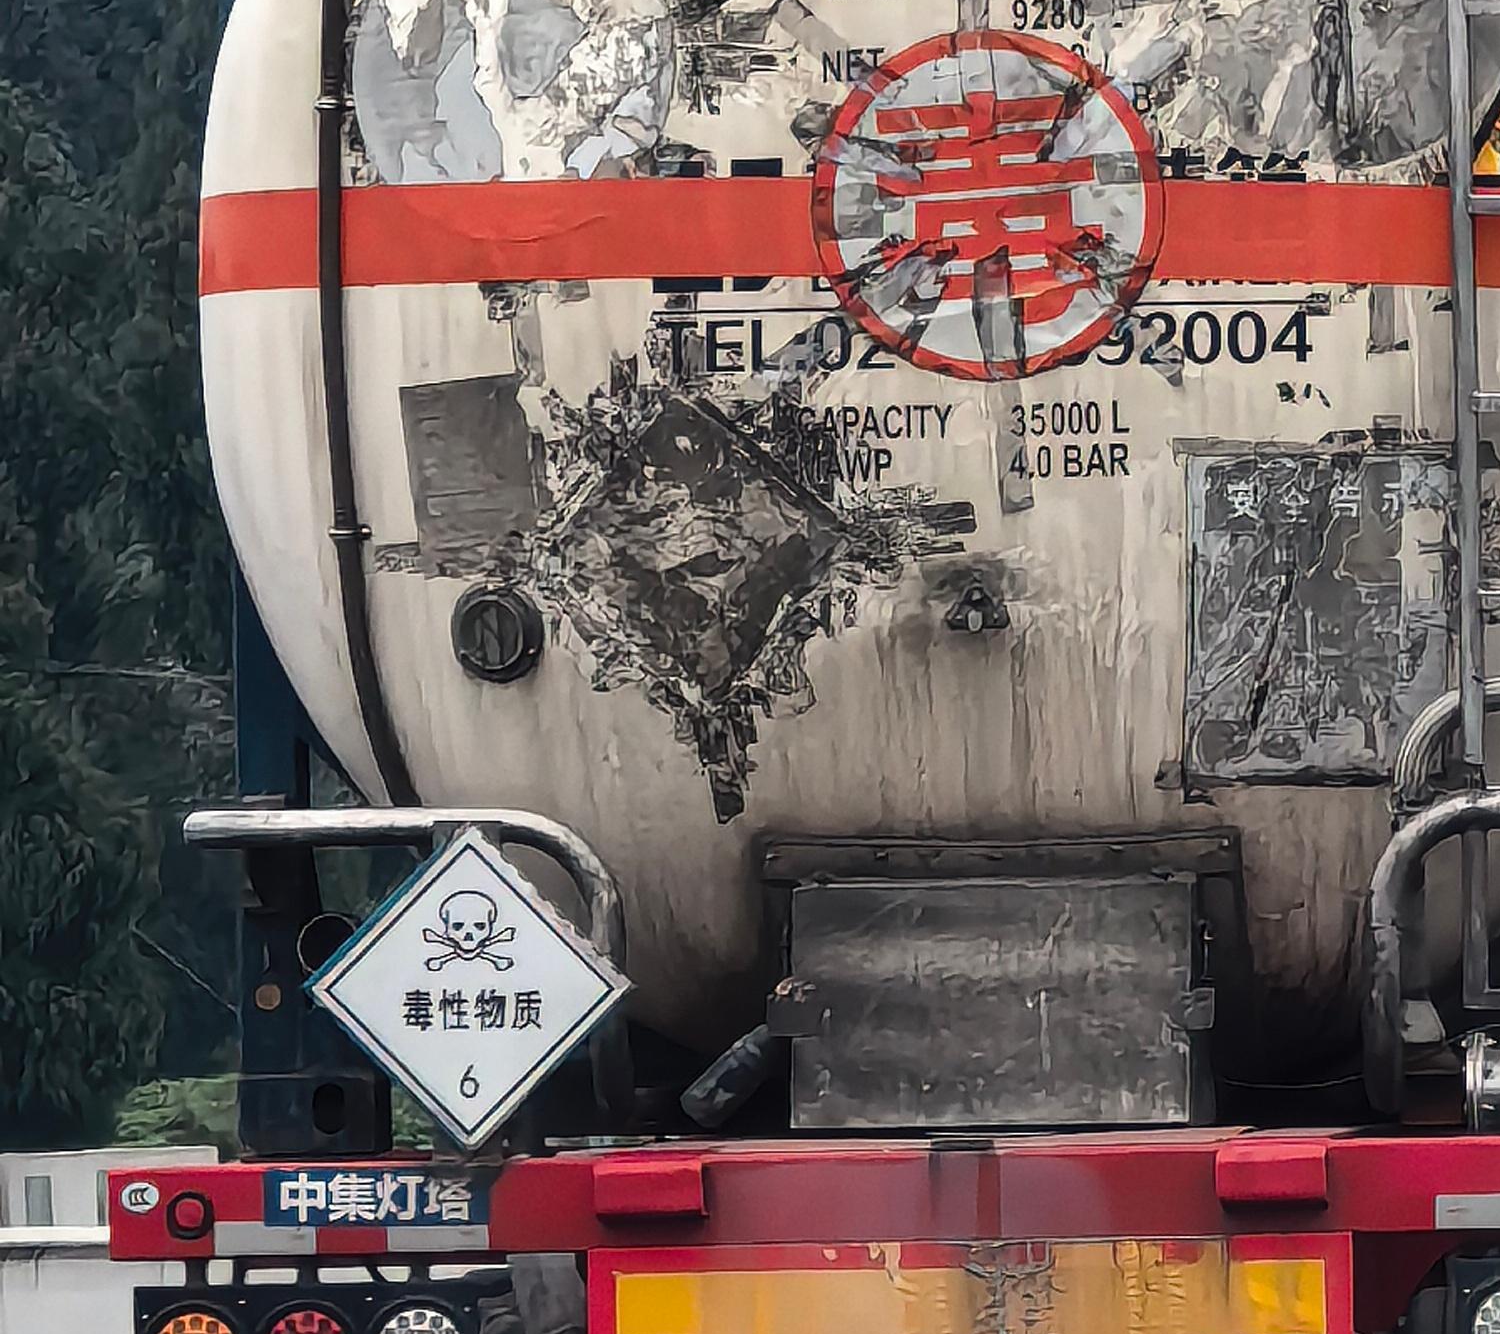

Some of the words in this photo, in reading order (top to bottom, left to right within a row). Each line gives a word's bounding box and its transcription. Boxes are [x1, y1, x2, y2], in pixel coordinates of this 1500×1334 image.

[1011, 399, 1103, 437] 35000
[1112, 399, 1130, 434] L
[1010, 445, 1052, 480] 4.0
[1063, 442, 1129, 478] BAR
[401, 988, 543, 1032] 毒性物质
[459, 1064, 480, 1099] 6
[279, 1172, 473, 1222] 中集灯塔
